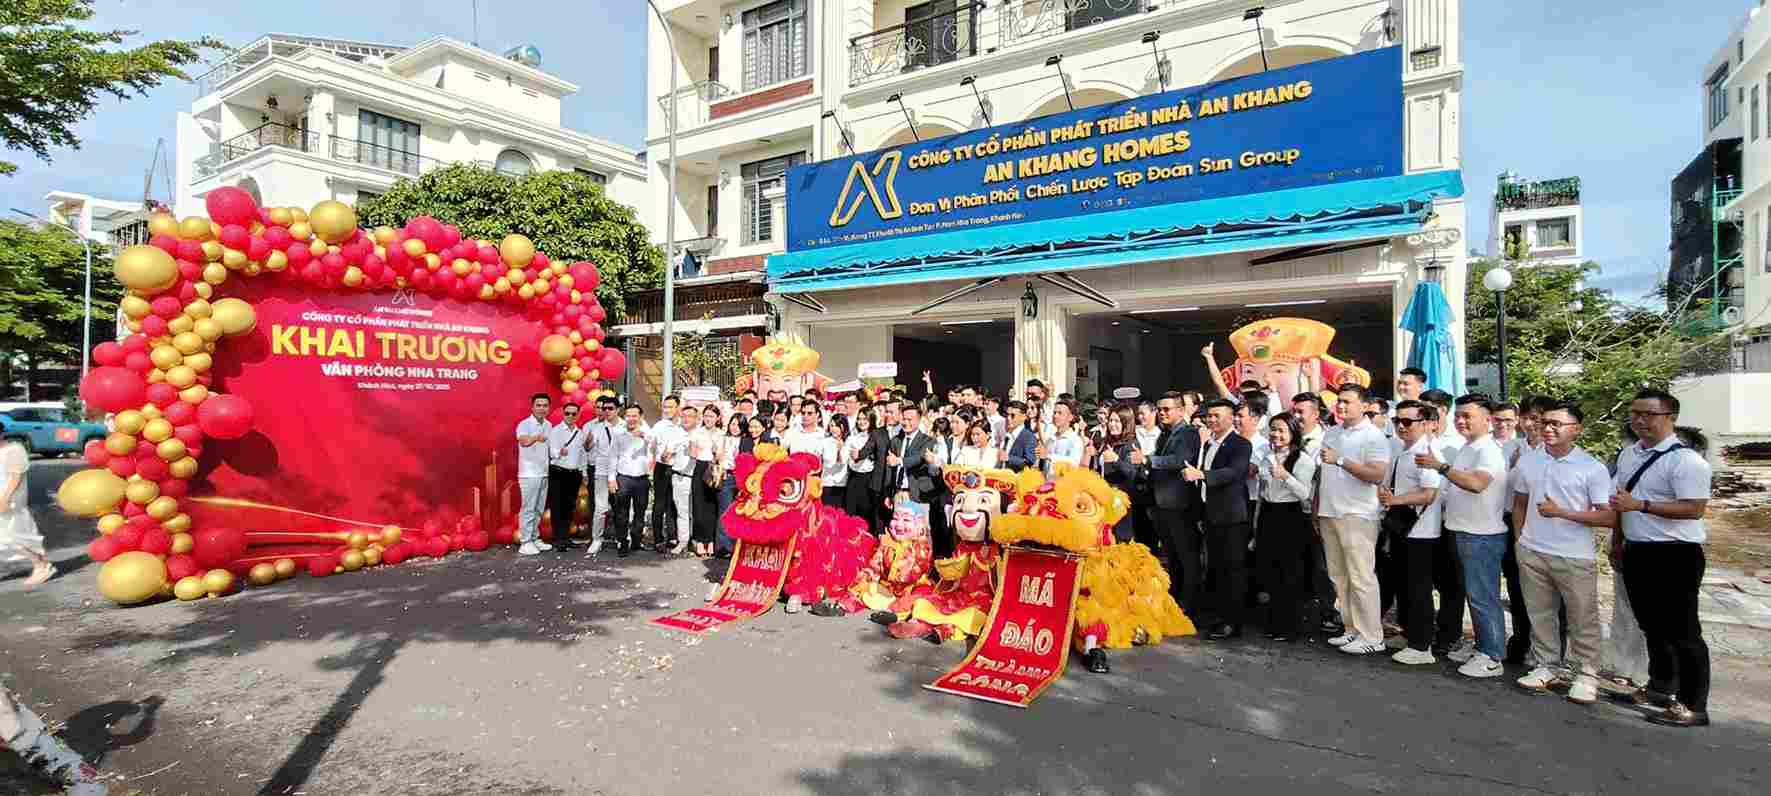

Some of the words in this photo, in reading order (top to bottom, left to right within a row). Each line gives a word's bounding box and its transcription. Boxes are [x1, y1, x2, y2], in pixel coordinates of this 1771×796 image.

[908, 149, 951, 168] CÔNG
[954, 145, 975, 160] TY
[975, 133, 1000, 156] CỔ
[1003, 127, 1046, 152] PHẦN
[1051, 120, 1094, 143] PHÁT
[1097, 107, 1148, 135] TRIỂN
[1151, 100, 1193, 125] NHÀ
[1199, 96, 1229, 117] AN
[1233, 80, 1313, 110] KHANG
[984, 160, 1014, 183] AN
[1018, 147, 1098, 178] KHANG
[1103, 130, 1191, 164] HOMES
[938, 198, 951, 214] Vị
[954, 193, 988, 209] Phân
[990, 185, 1020, 204] Phối
[1026, 179, 1068, 198] Chiến
[1071, 175, 1109, 195] Lược
[1199, 157, 1233, 173] Sun
[1239, 148, 1301, 168] Group
[302, 310, 332, 323] CÔNG
[334, 313, 346, 324] TY
[271, 324, 366, 358] KHAI
[375, 329, 513, 365] TRƯƠNG
[321, 361, 352, 377] VĂN
[354, 362, 405, 378] PHÒNG
[407, 366, 434, 379] NHA
[436, 368, 479, 381] TRANG
[1018, 571, 1056, 608] MÃ
[1000, 618, 1054, 656] ĐÁO
